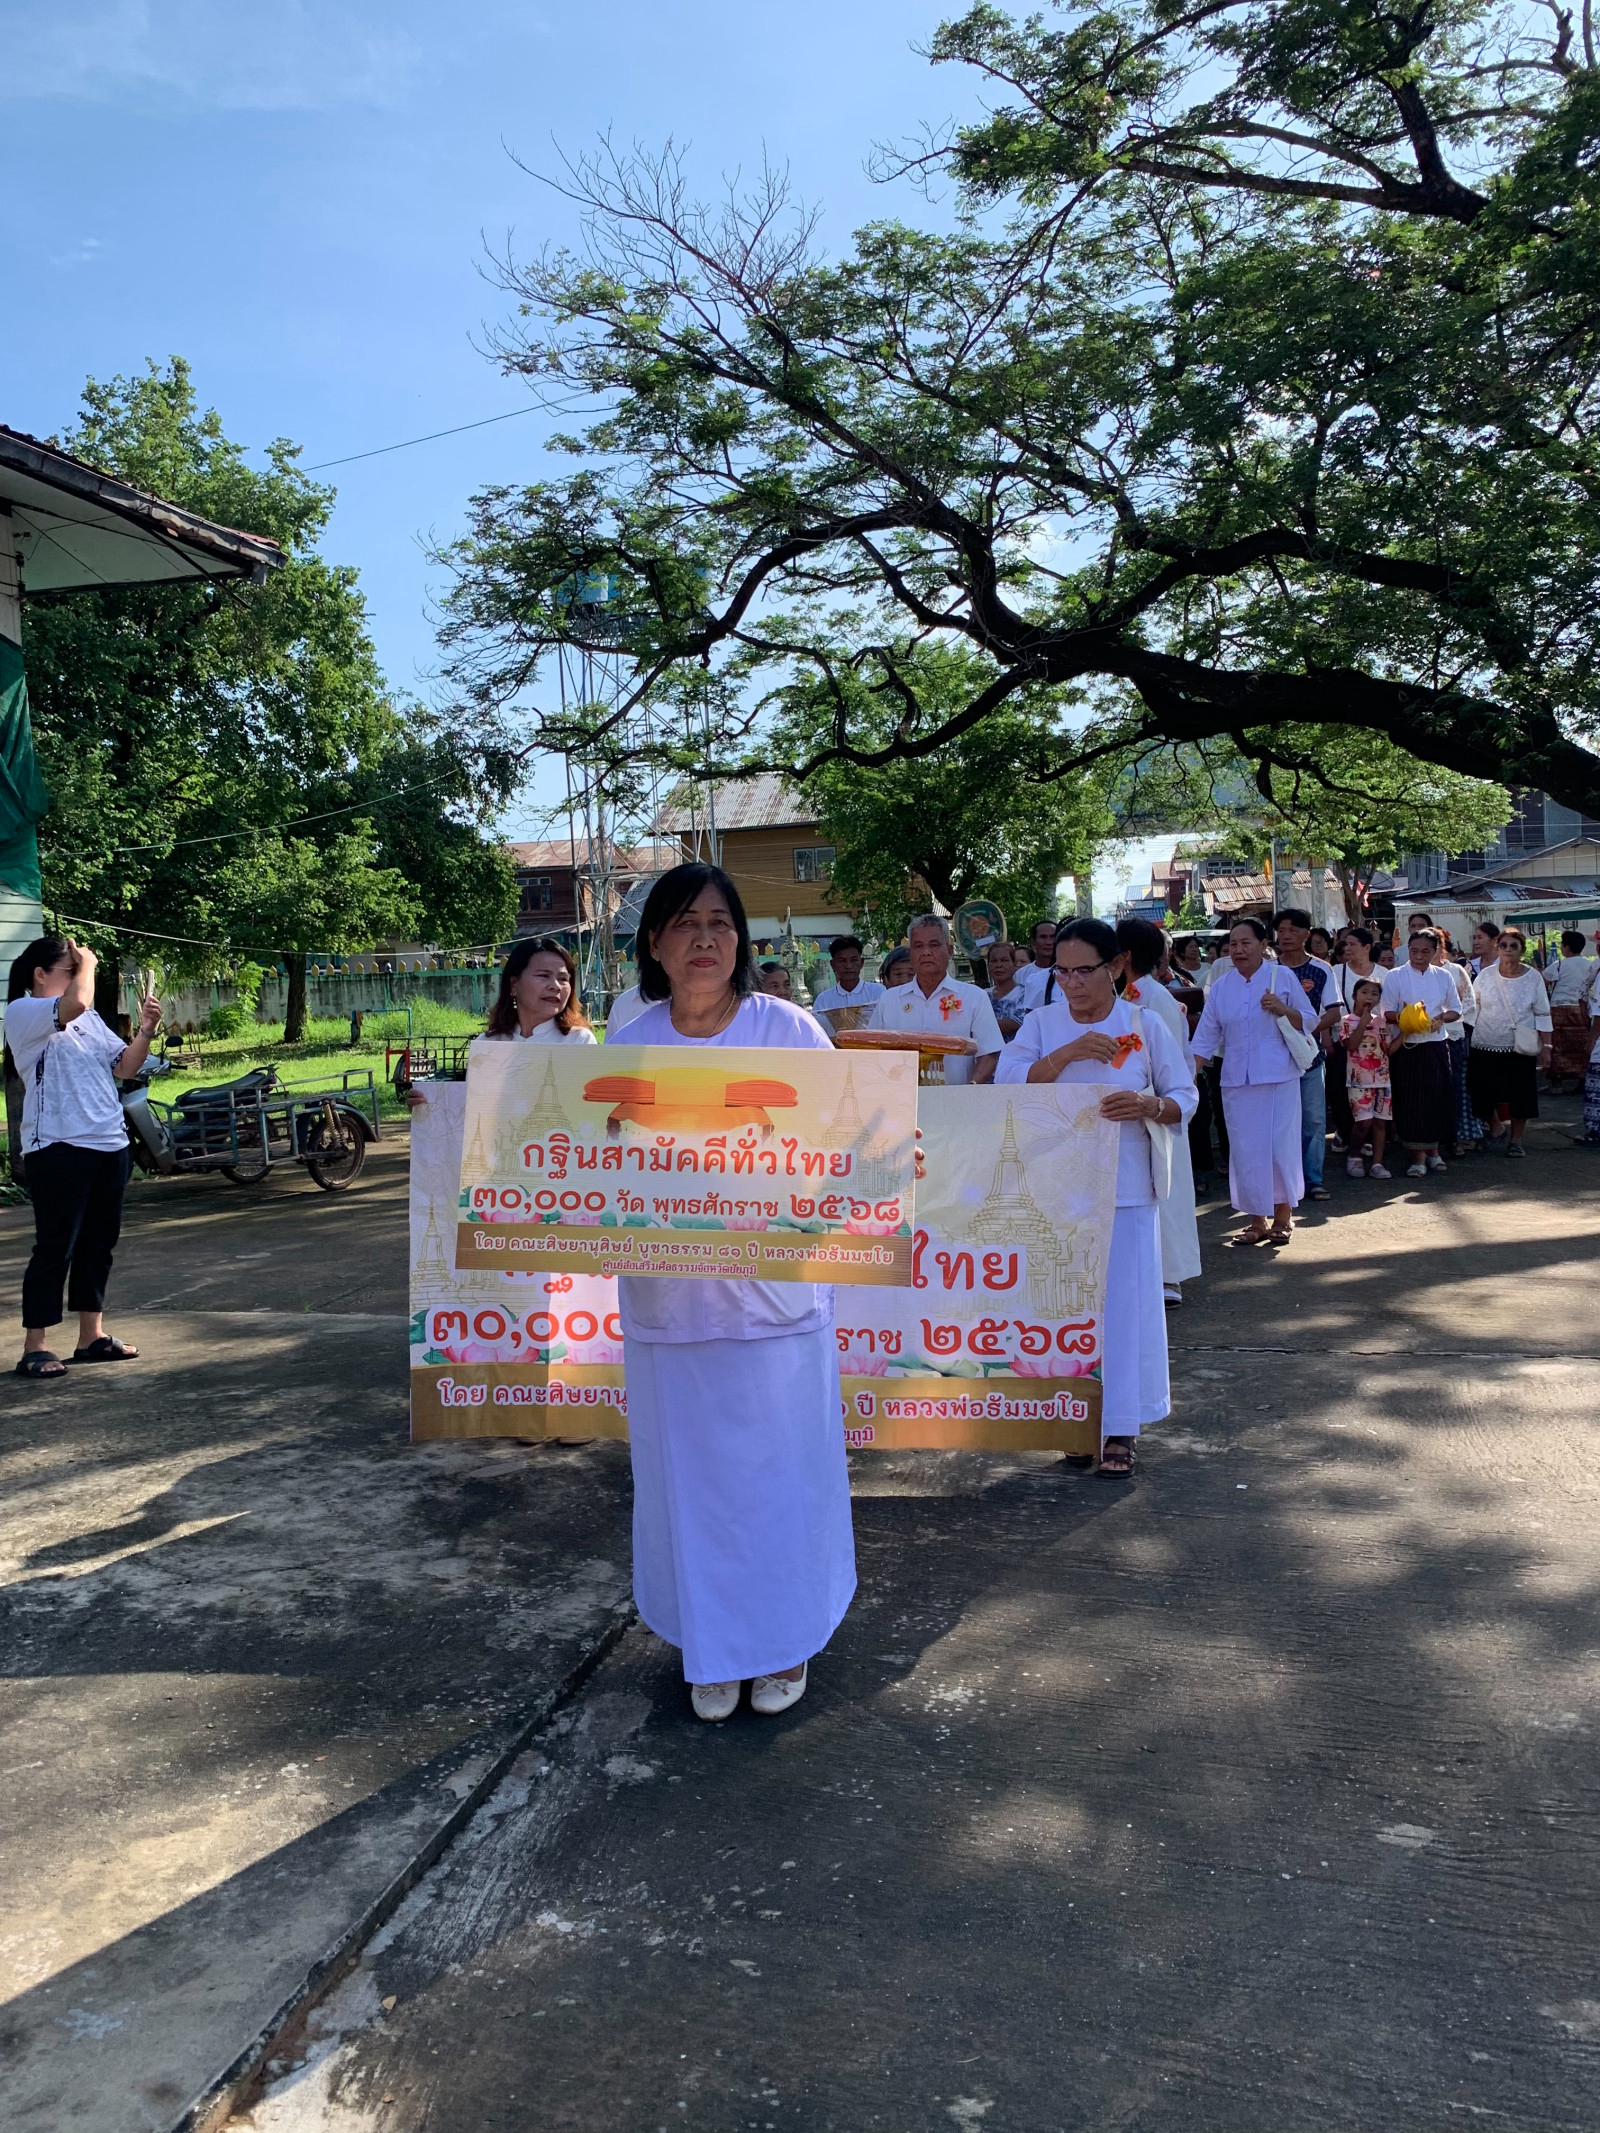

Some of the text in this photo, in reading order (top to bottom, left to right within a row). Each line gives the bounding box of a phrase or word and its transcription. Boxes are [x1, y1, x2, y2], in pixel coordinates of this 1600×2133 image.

[523, 1128, 852, 1179] กฐินสามัคคีทั่วไทย
[473, 1187, 902, 1223] ๓๐,๐๐๐ วัด พุทธศักราช ๒๕๖๘
[474, 1233, 893, 1263] โดย คณะศิษยานุศิษย์ บูชาธรรม ๘๑ ปี หลวงพ่อธัมมชโย
[920, 1318, 1097, 1356] ๒๕๖๘
[440, 1381, 485, 1404] โดย
[857, 1393, 874, 1416] ปี
[885, 1395, 1088, 1419] หลวงพ่อธัมมชโย
